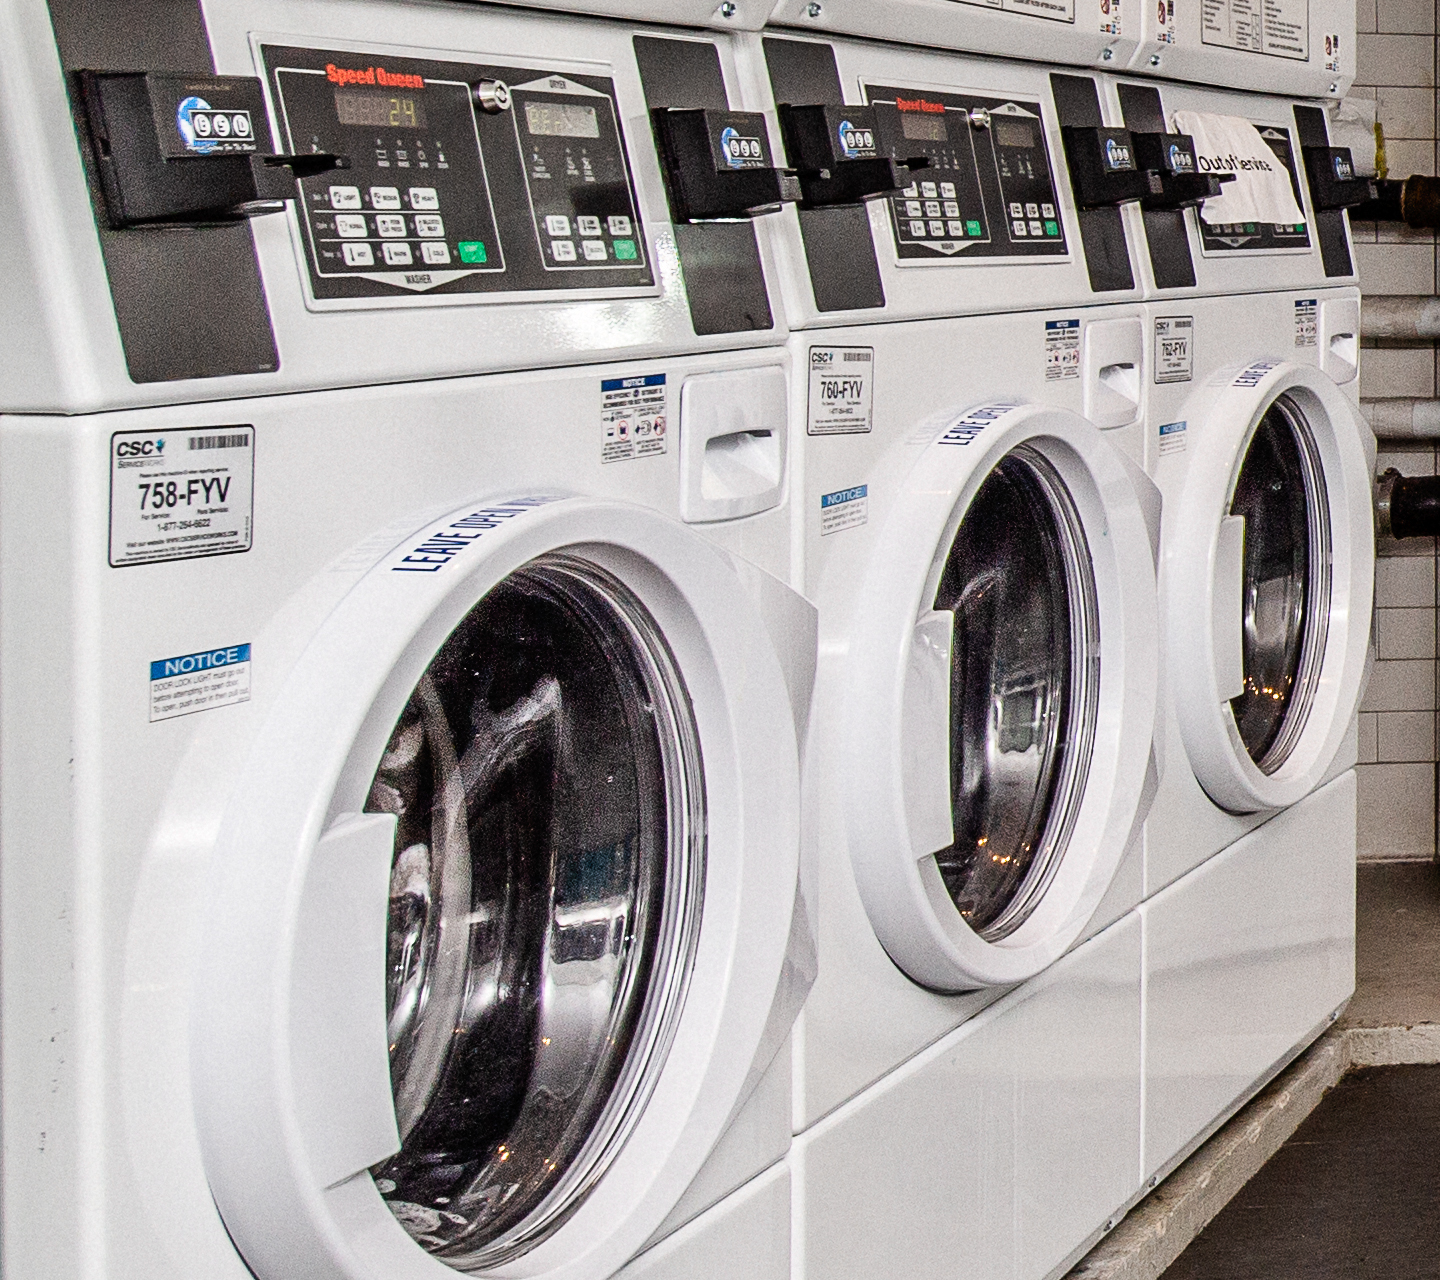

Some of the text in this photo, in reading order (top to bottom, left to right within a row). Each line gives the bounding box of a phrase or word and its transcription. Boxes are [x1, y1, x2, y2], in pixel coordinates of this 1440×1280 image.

[325, 63, 424, 88] Speed Queen
[390, 98, 416, 127] 24
[896, 97, 945, 113] Speed Queen
[404, 274, 432, 284] WASHER
[1161, 341, 1187, 356] 762-FYV
[812, 352, 828, 363] CSC
[820, 381, 863, 399] 760-FYV
[117, 441, 154, 457] CSC
[138, 476, 231, 510] 758-FYV
[827, 488, 863, 505] NOTICE
[391, 507, 528, 572] LEAVE OPEN
[165, 648, 239, 675] NOTICE
